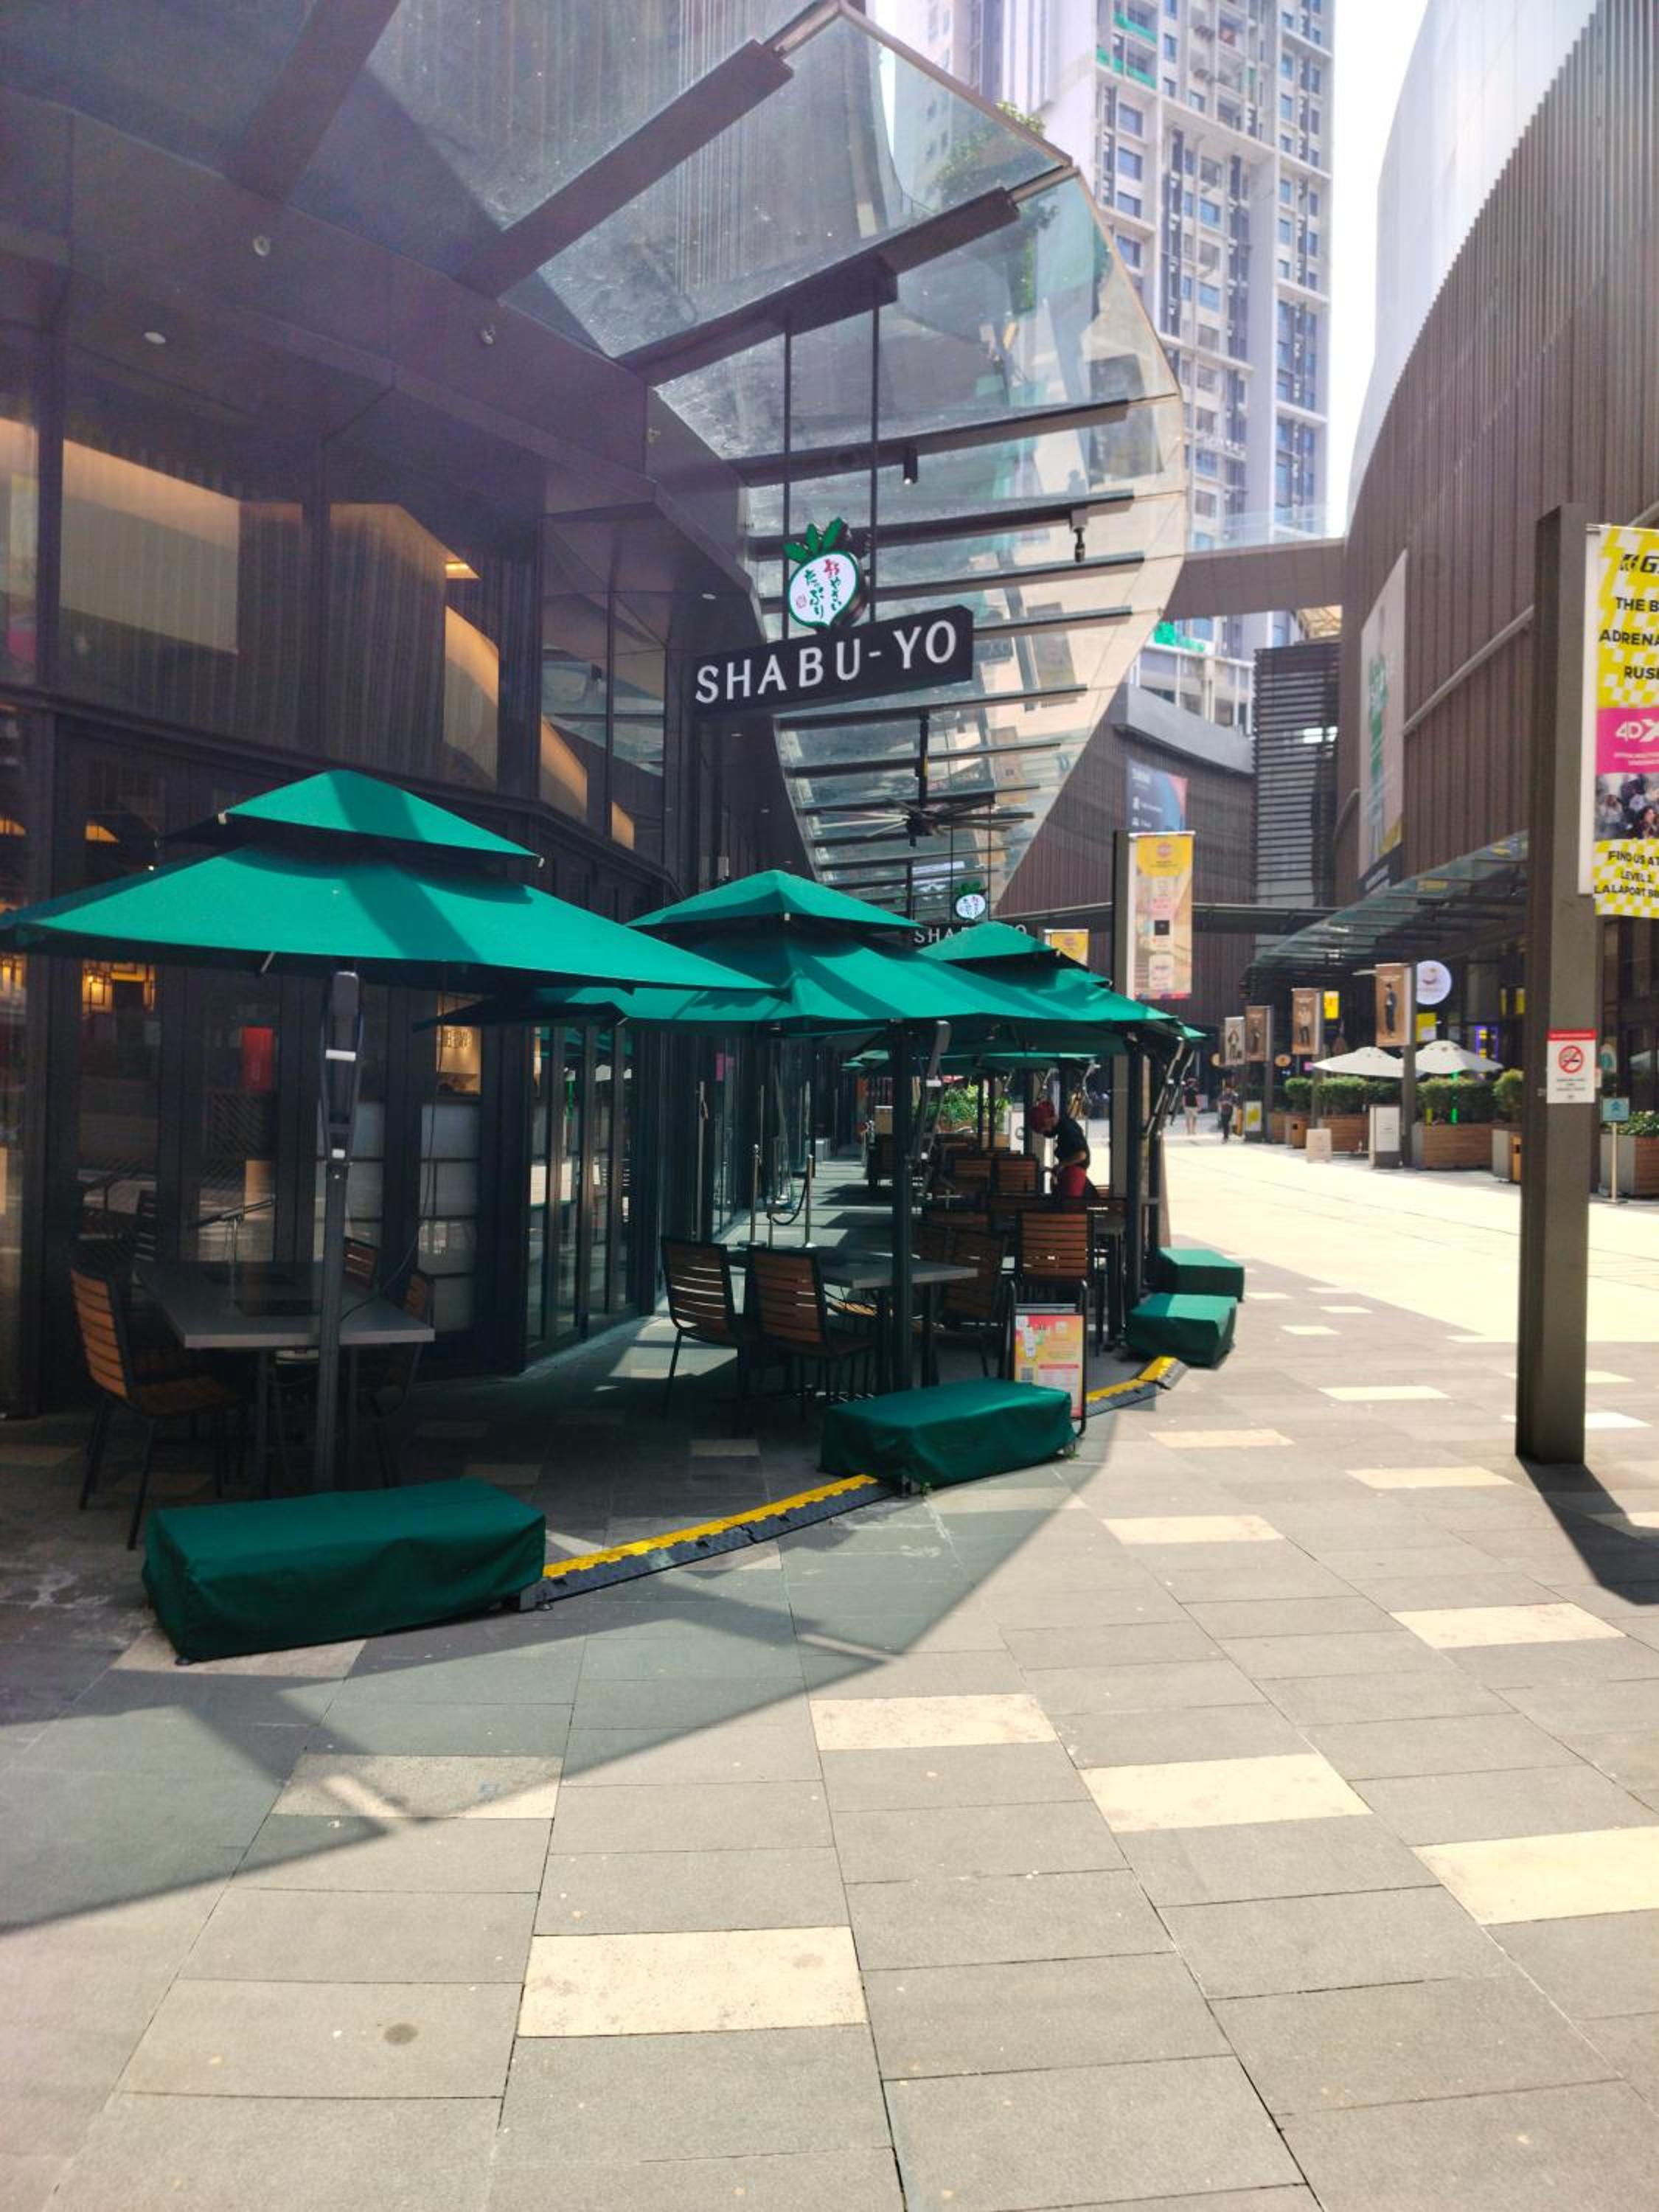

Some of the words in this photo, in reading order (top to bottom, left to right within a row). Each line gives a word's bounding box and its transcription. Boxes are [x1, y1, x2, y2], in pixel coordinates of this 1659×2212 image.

[1615, 597, 1646, 611] THE
[695, 619, 956, 703] SHABU-YO
[1608, 850, 1632, 862] FIND
[1633, 853, 1645, 864] US
[1620, 871, 1645, 882] LEVEL
[1593, 885, 1645, 897] LALAPORT
